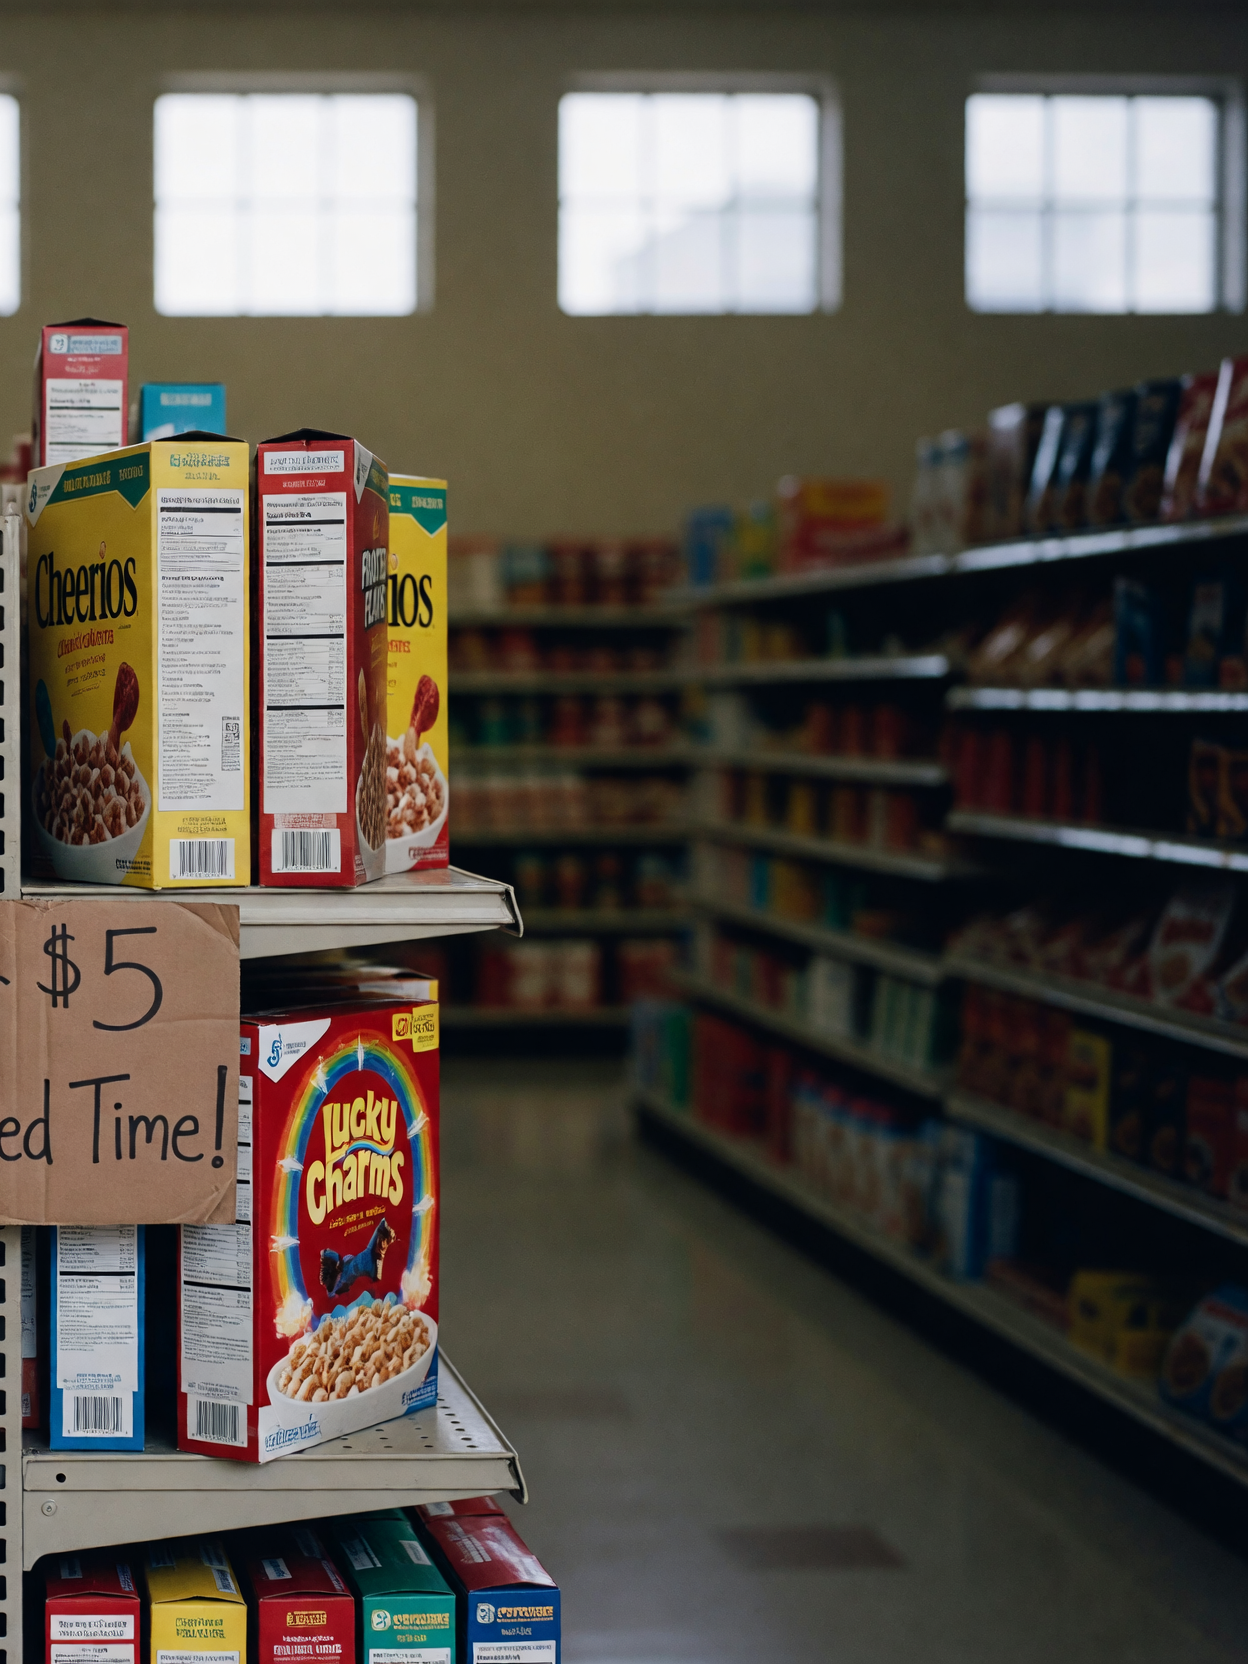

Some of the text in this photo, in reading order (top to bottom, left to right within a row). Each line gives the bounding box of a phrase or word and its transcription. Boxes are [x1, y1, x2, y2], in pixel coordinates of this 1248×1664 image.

[35, 549, 138, 629] Cheerios
[36, 922, 164, 1032] $5
[68, 1064, 228, 1169] Time!
[322, 1089, 398, 1165] Lucky
[306, 1149, 405, 1225] Charms
